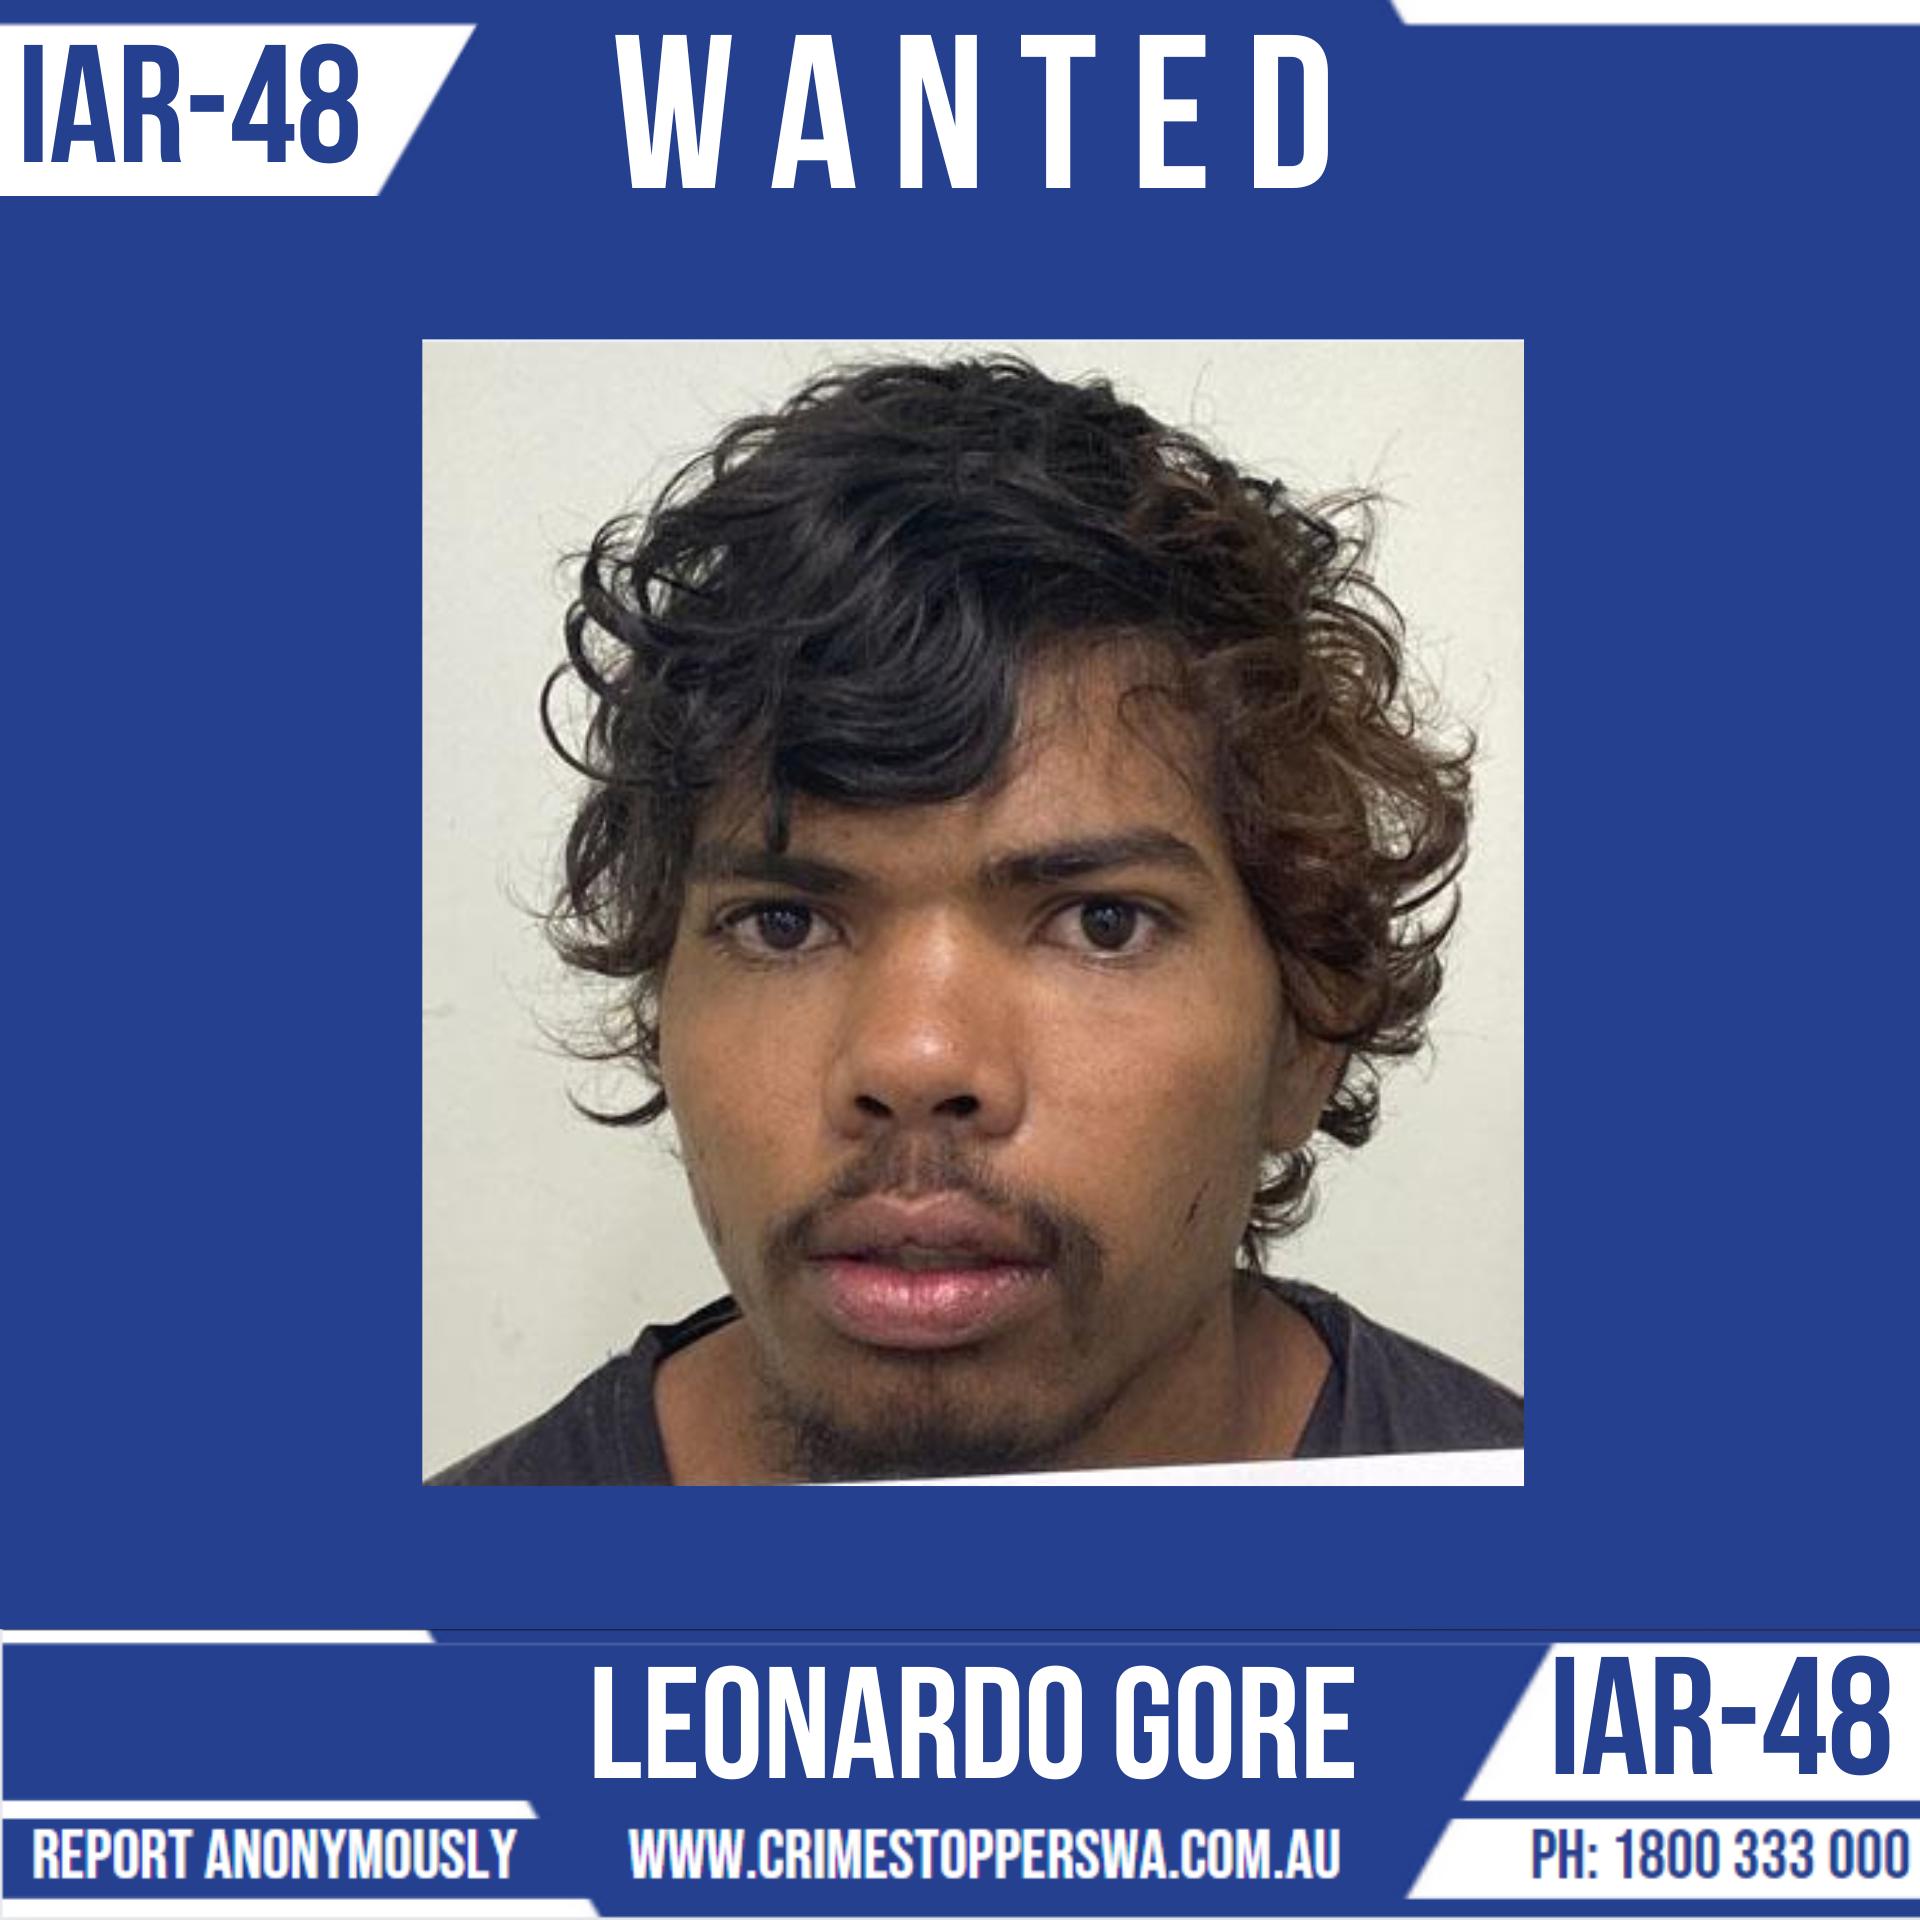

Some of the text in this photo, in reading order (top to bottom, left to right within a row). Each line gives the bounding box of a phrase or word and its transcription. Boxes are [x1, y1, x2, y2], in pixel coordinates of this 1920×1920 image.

[24, 44, 358, 163] IAR-48
[615, 35, 1328, 188] WANTED
[594, 1666, 1354, 1779] LEONARDO GORE
[1554, 1655, 1889, 1775] IAR-48
[34, 1829, 517, 1879] REPORT ANONYMOUSLY
[629, 1829, 1340, 1879] WWW.CRIMESTOPPERSWA.COM.AU
[1534, 1829, 1909, 1878] PH: 1800 333 000
